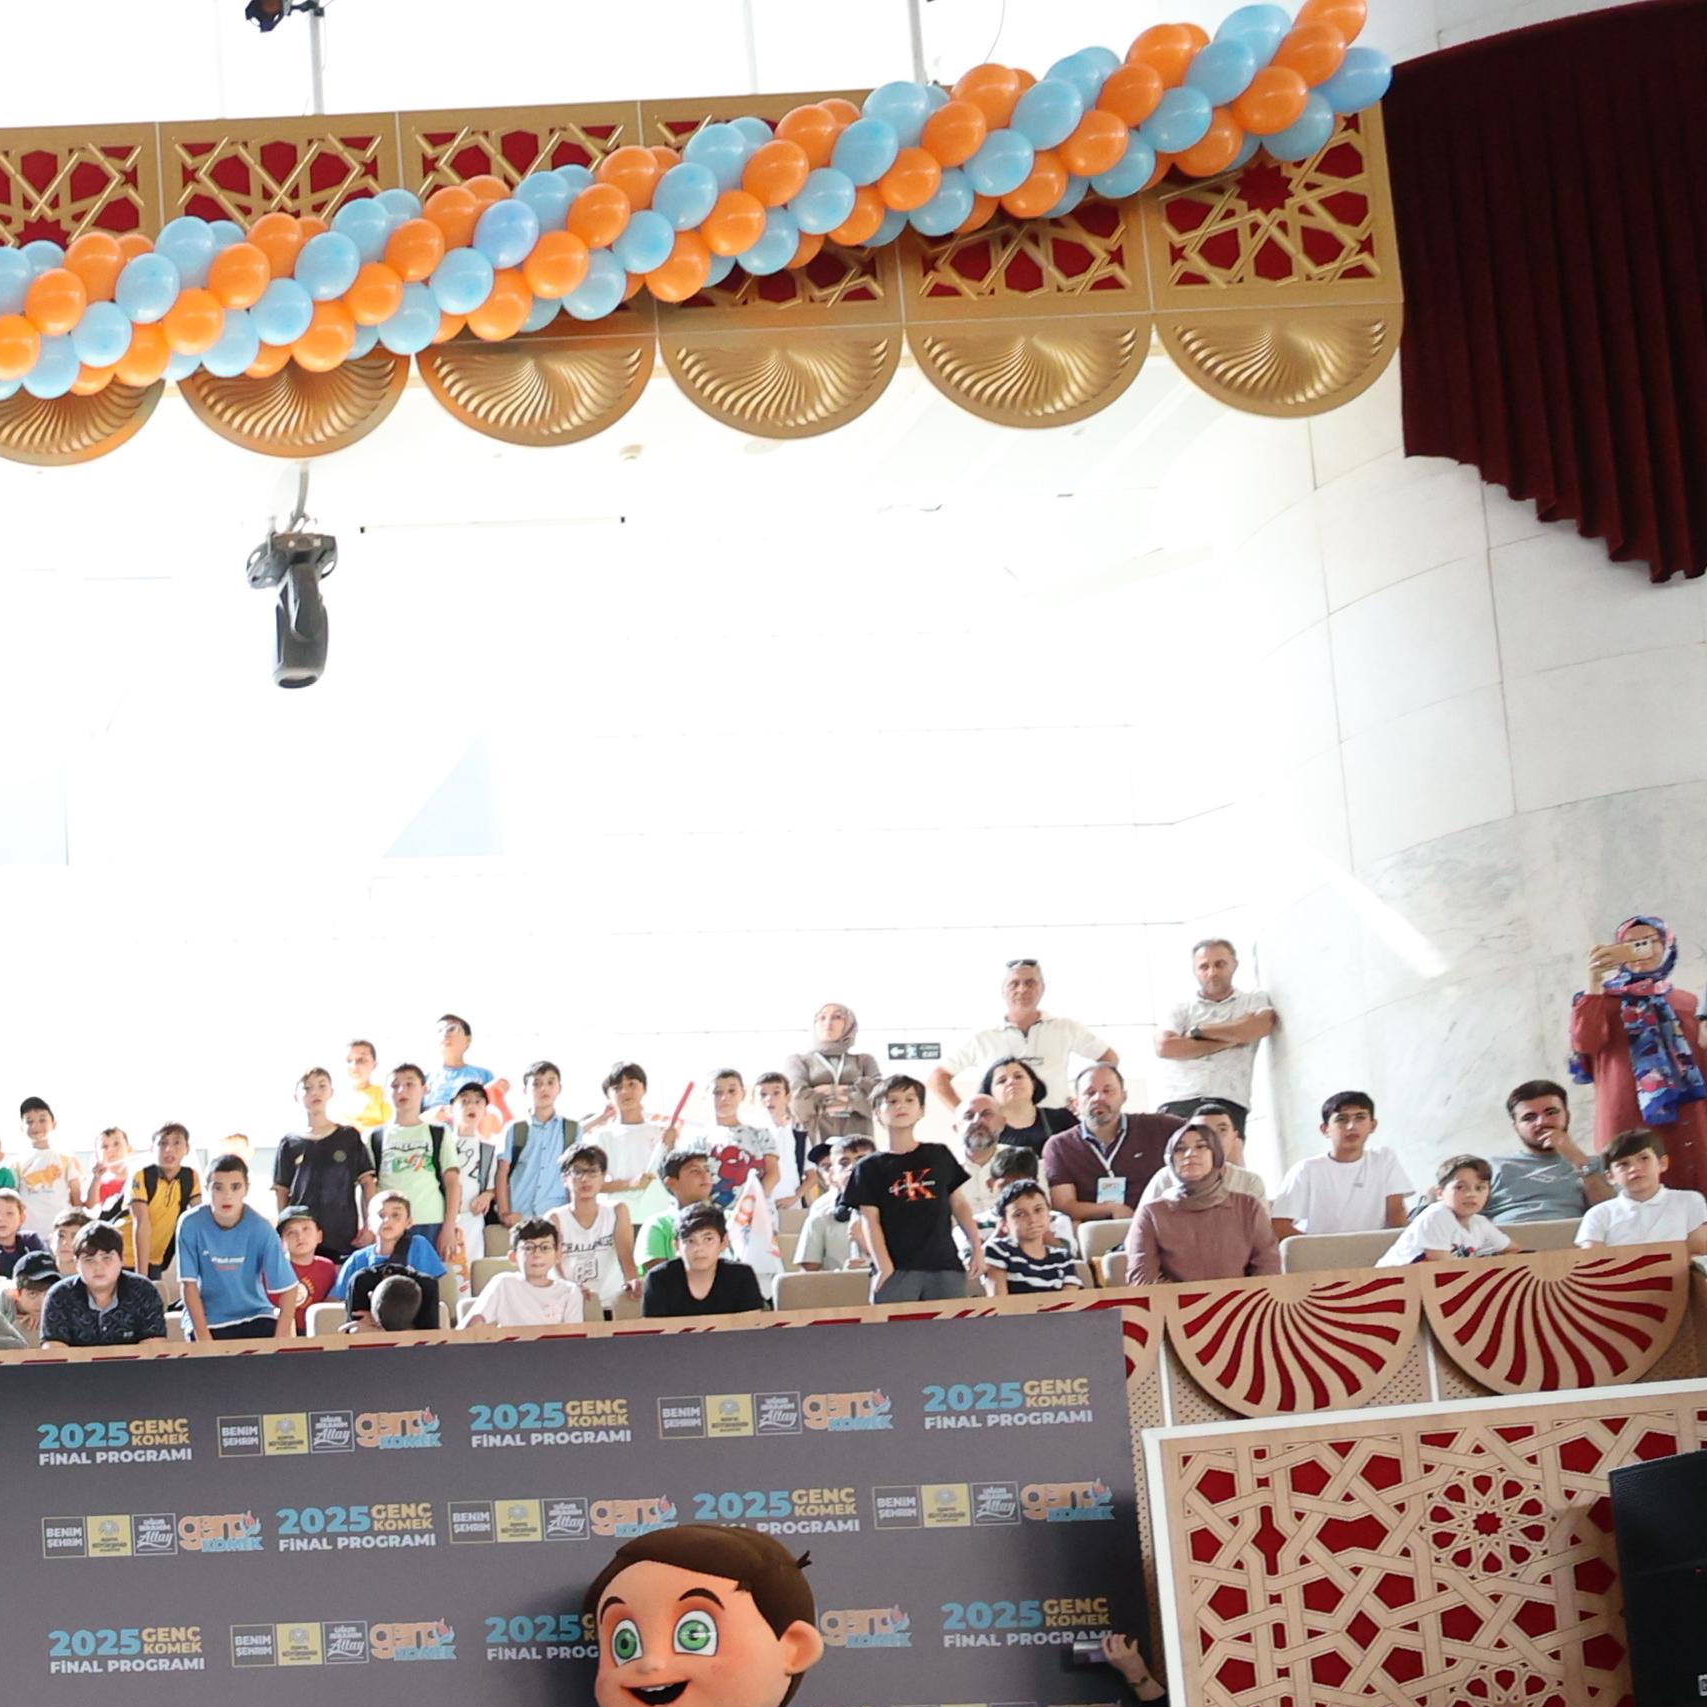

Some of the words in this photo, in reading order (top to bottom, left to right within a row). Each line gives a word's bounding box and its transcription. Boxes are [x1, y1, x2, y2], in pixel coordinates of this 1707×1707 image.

[923, 1381, 1024, 1412] 2025
[1025, 1393, 1088, 1407] KOMEK
[469, 1401, 566, 1431] 2025
[567, 1414, 628, 1426] KOMEK
[987, 1410, 1092, 1426] PROGRAMI
[37, 1420, 130, 1449] 2025
[130, 1433, 190, 1446] KOMEK
[531, 1430, 631, 1445] PROGRAMI
[96, 1448, 191, 1463] PROGRAMI
[694, 1490, 792, 1520] 2025
[793, 1503, 855, 1516] KOMEK
[277, 1505, 371, 1535] 2025
[373, 1517, 432, 1531] KOMEK
[757, 1520, 859, 1534] PROGRAMI
[338, 1534, 435, 1549] PROGRAMI
[943, 1600, 1043, 1629] 2025
[1045, 1612, 1110, 1627] KOMEK
[485, 1613, 582, 1642] 2025
[49, 1628, 142, 1657] 2025
[144, 1641, 201, 1653] KOMEK
[108, 1658, 204, 1672] PROGRAMI
